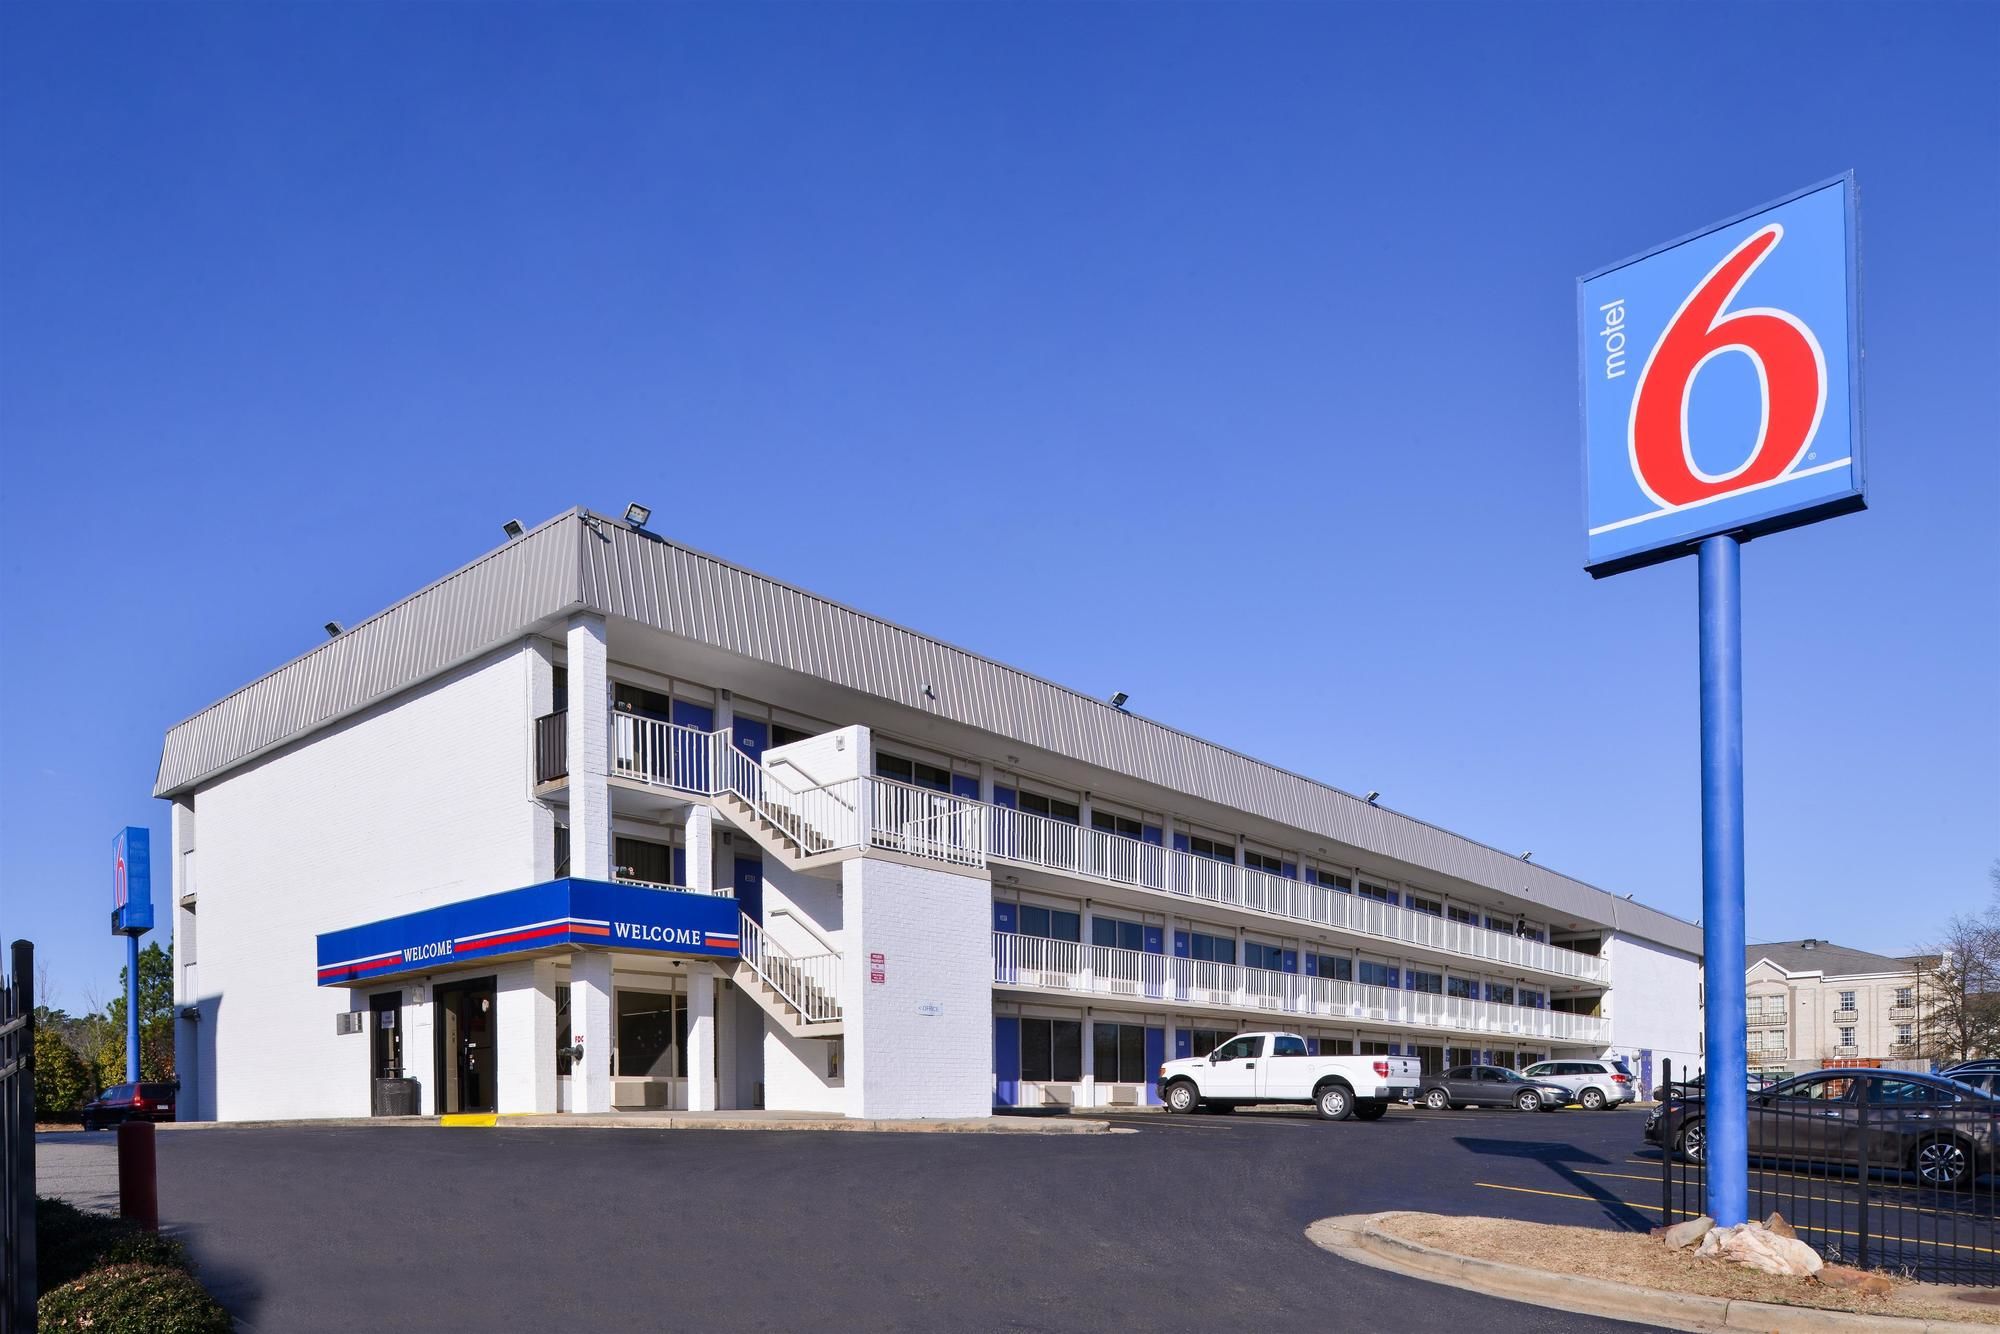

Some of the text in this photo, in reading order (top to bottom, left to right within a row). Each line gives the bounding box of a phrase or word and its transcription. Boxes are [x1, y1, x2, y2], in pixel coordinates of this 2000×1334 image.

[1600, 222, 1828, 512] motel 6
[115, 834, 127, 909] 6
[403, 939, 452, 962] WELCOME
[614, 922, 701, 945] WELCOME
